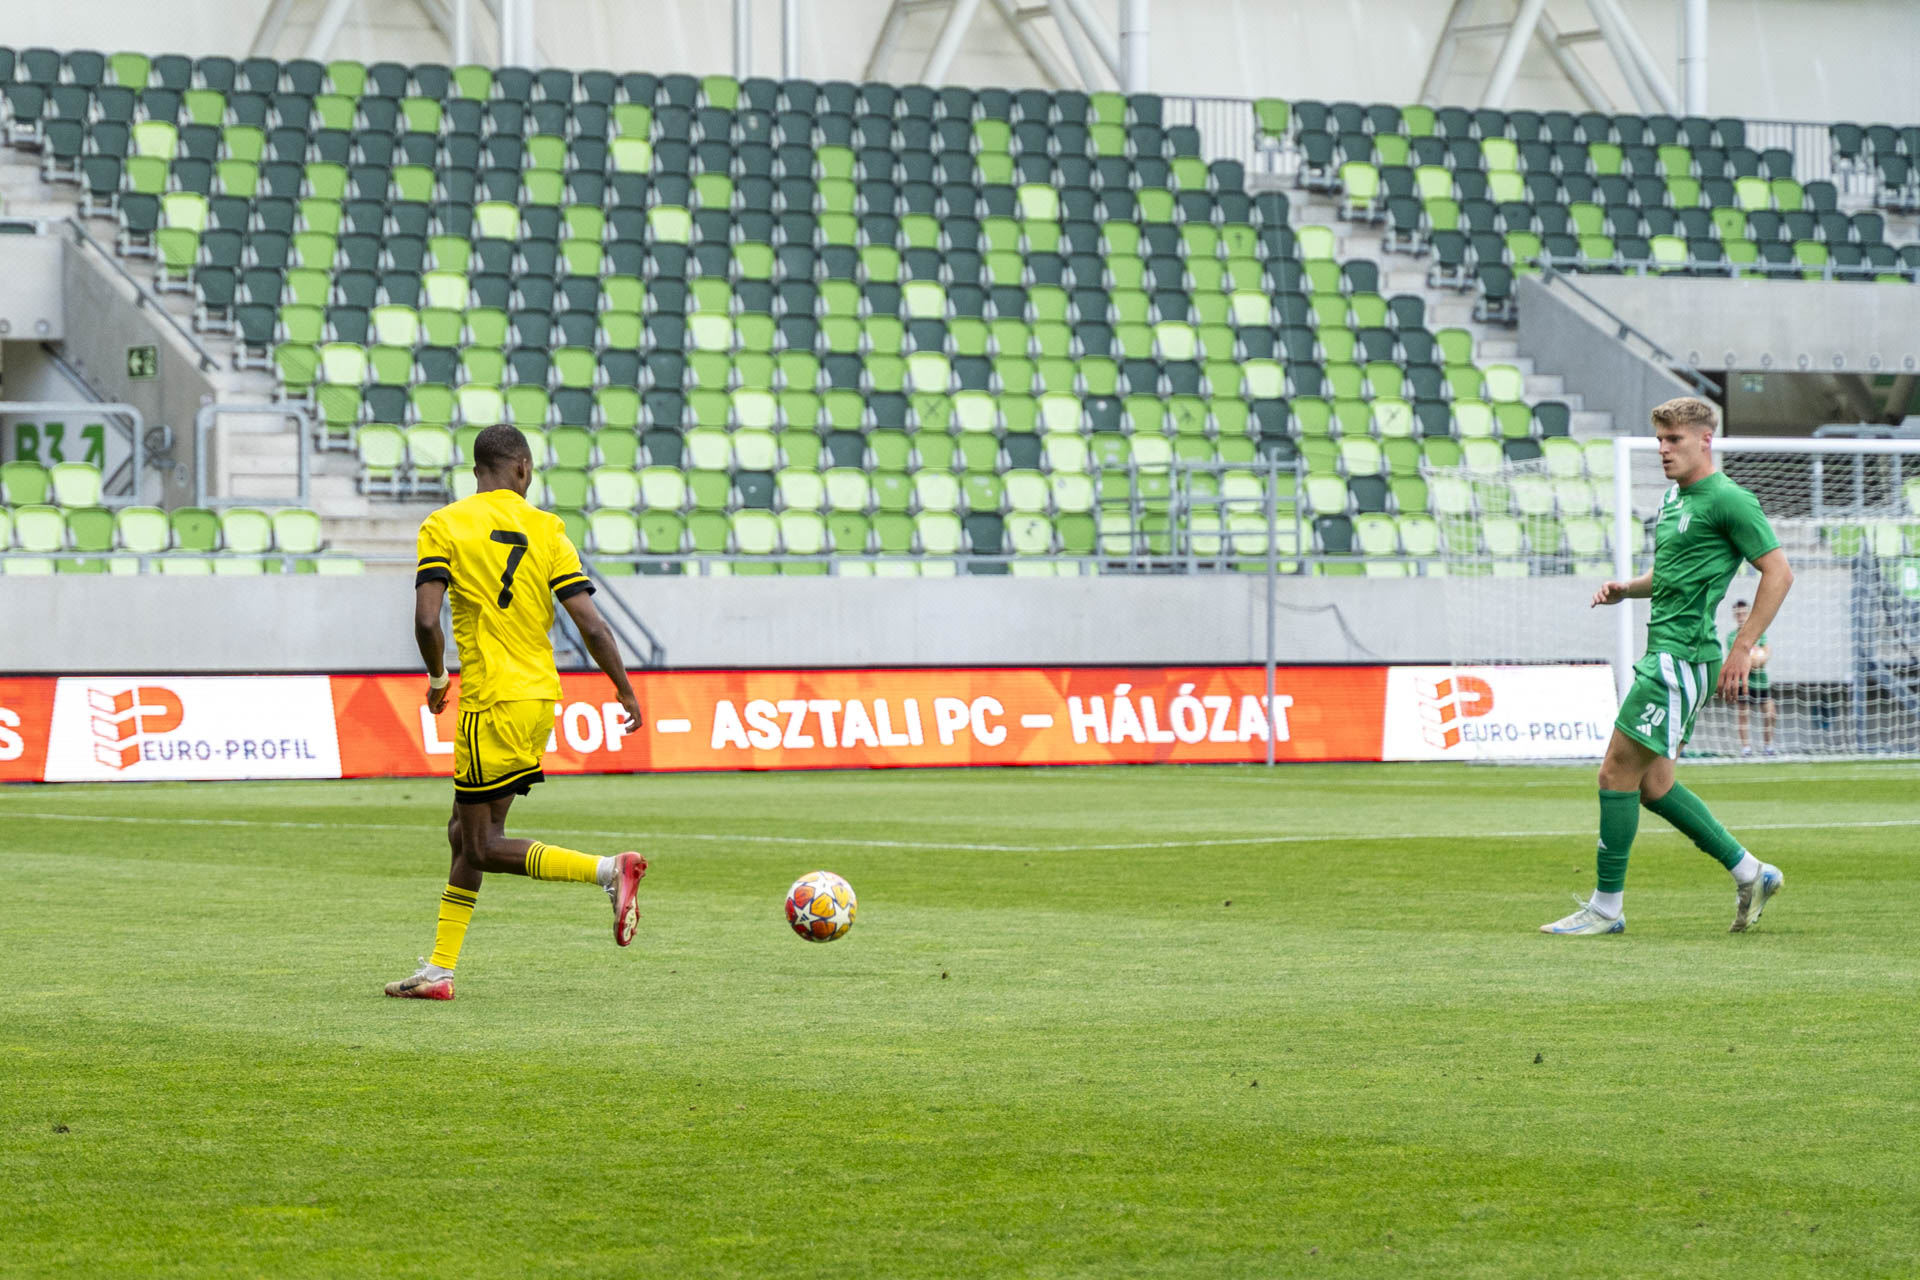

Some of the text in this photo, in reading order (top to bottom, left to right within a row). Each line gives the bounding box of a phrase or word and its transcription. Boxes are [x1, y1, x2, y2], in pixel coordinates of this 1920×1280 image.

[490, 529, 529, 609] 7
[711, 699, 925, 750] ASZTALI
[933, 696, 1008, 746] PC
[1067, 683, 1294, 744] HÁLÓZAT
[1640, 702, 1667, 727] 20
[1462, 721, 1606, 742] EURO-PROFIL
[143, 738, 316, 761] EURO-PROFIL
